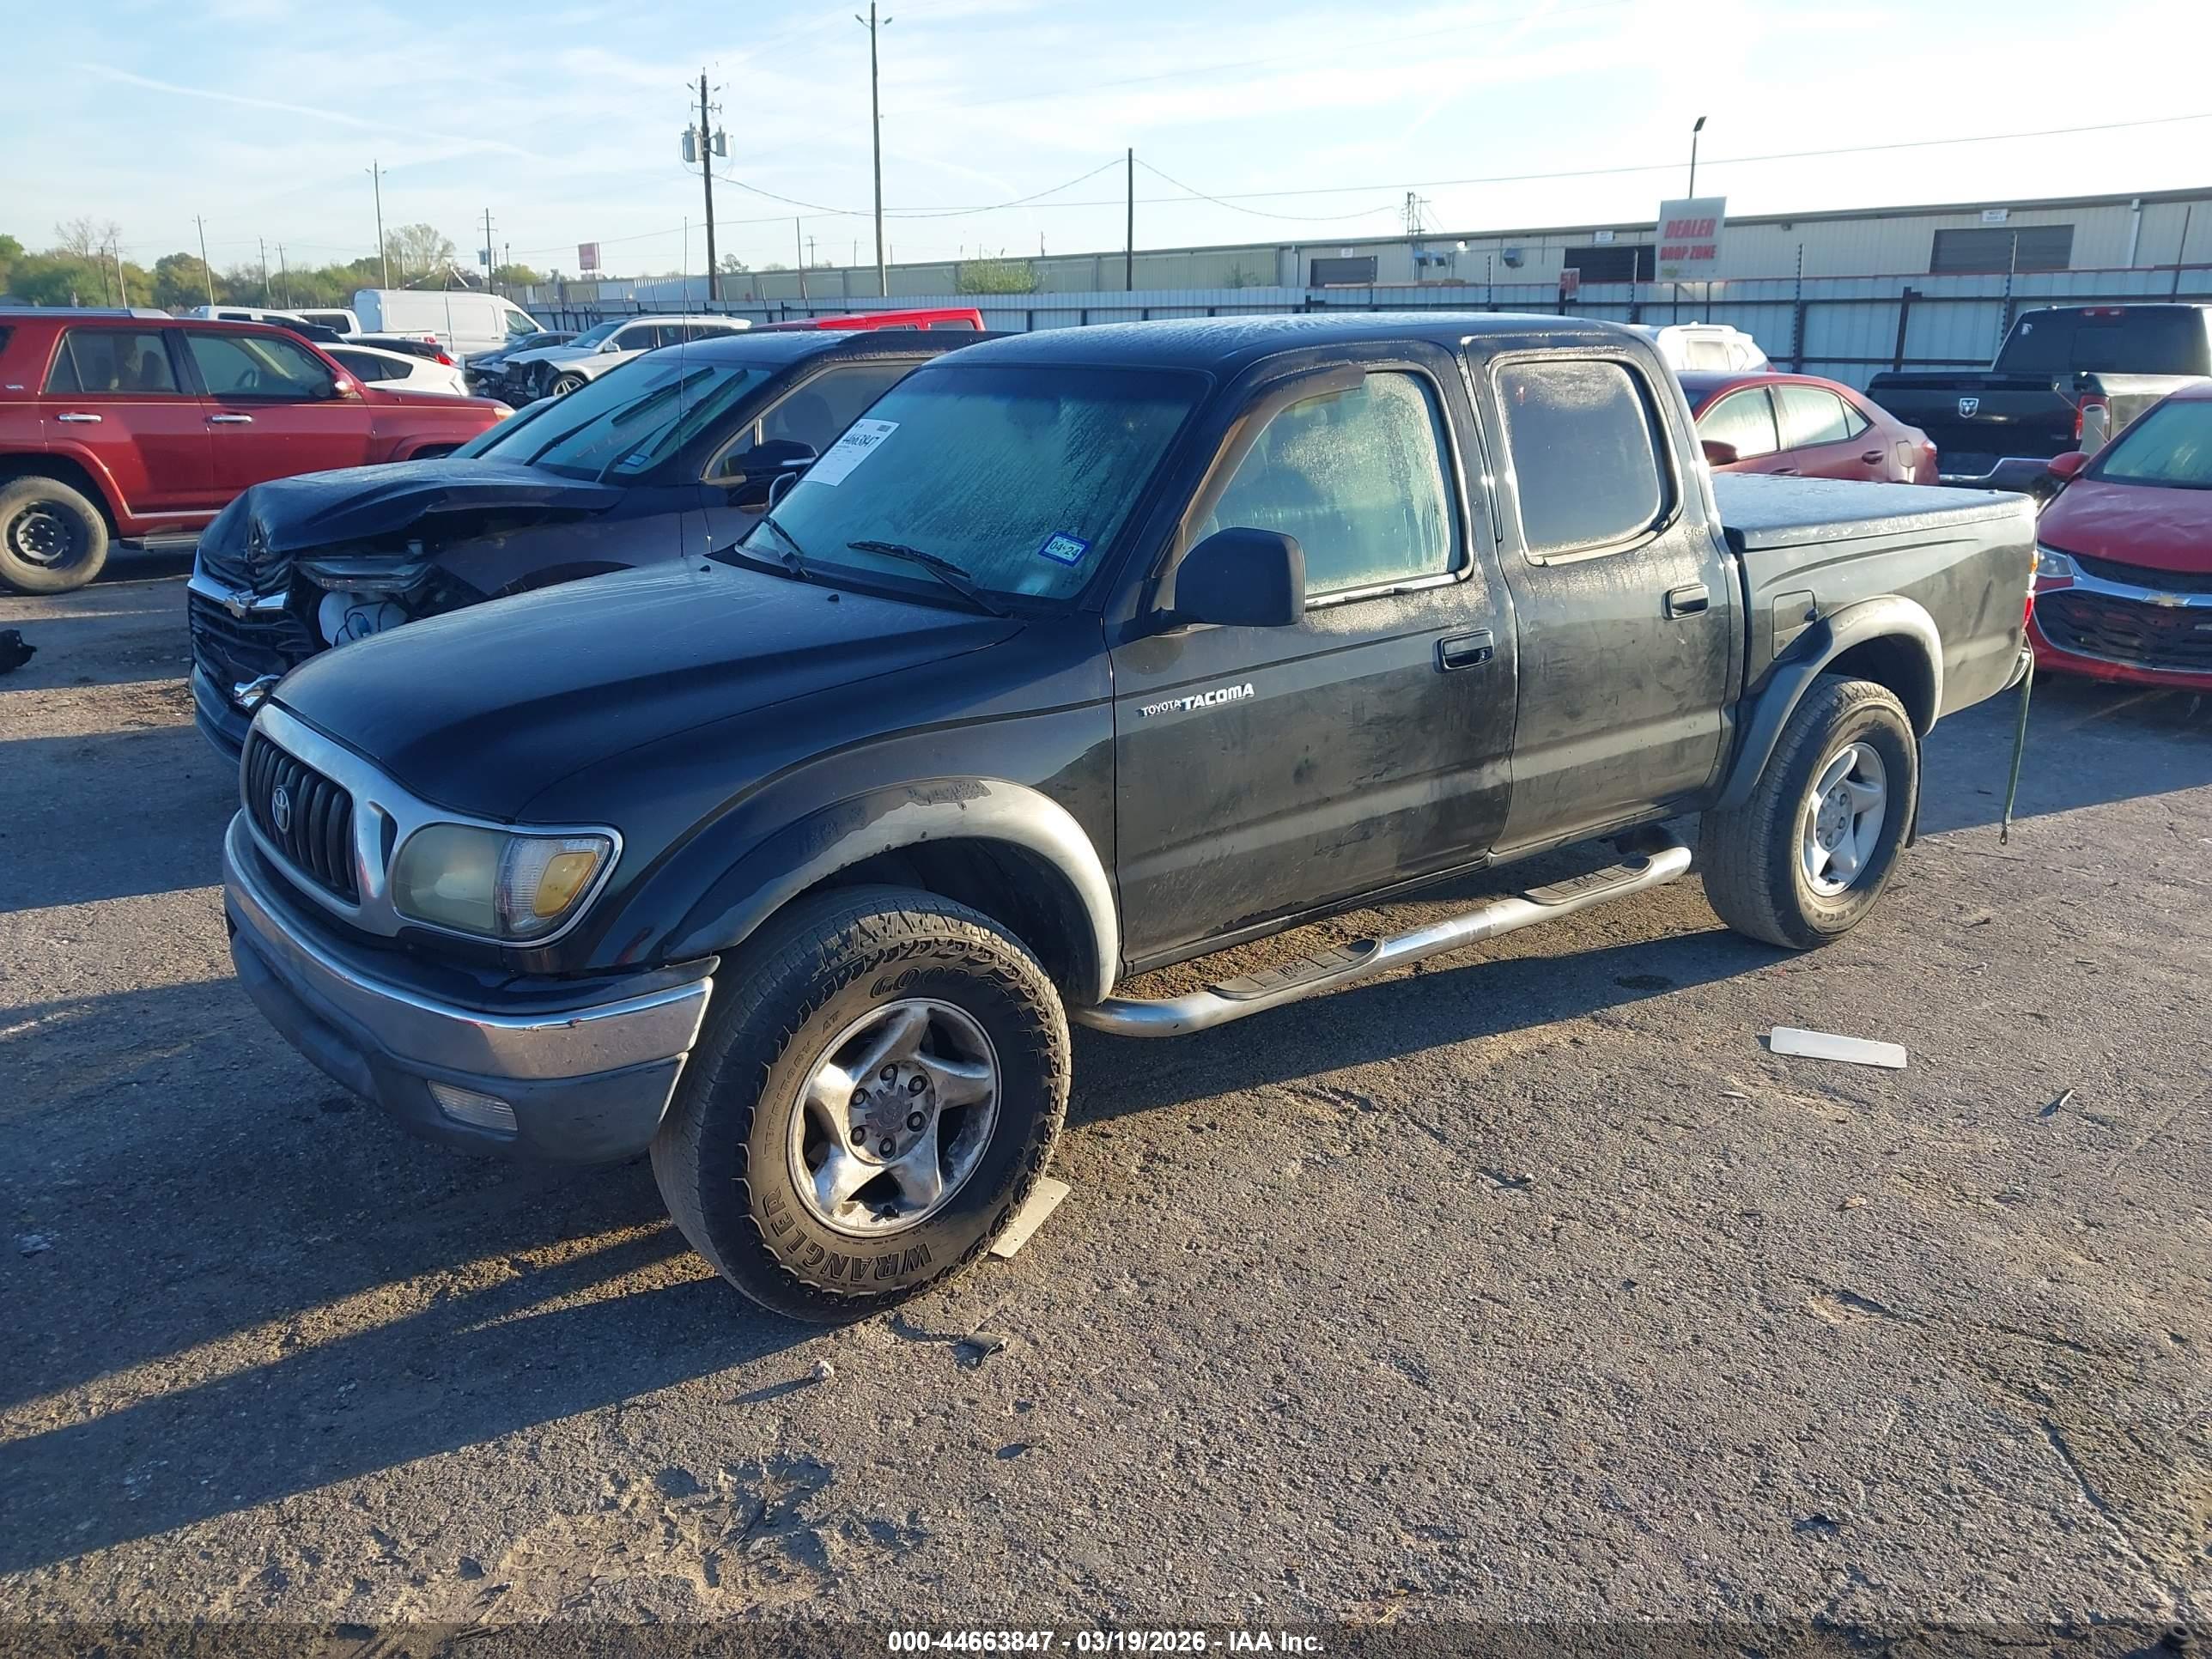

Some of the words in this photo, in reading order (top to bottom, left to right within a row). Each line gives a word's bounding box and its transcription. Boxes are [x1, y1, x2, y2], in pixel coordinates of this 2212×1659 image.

[1664, 218, 1717, 239] DEALER
[1660, 246, 1689, 261] DROP
[1689, 244, 1717, 260] ZONE
[1049, 541, 1063, 552] 04
[1064, 546, 1080, 557] 24
[1140, 699, 1182, 717] TOYOTA
[1181, 683, 1255, 711] TACOMA
[762, 1187, 934, 1281] WRANGLER
